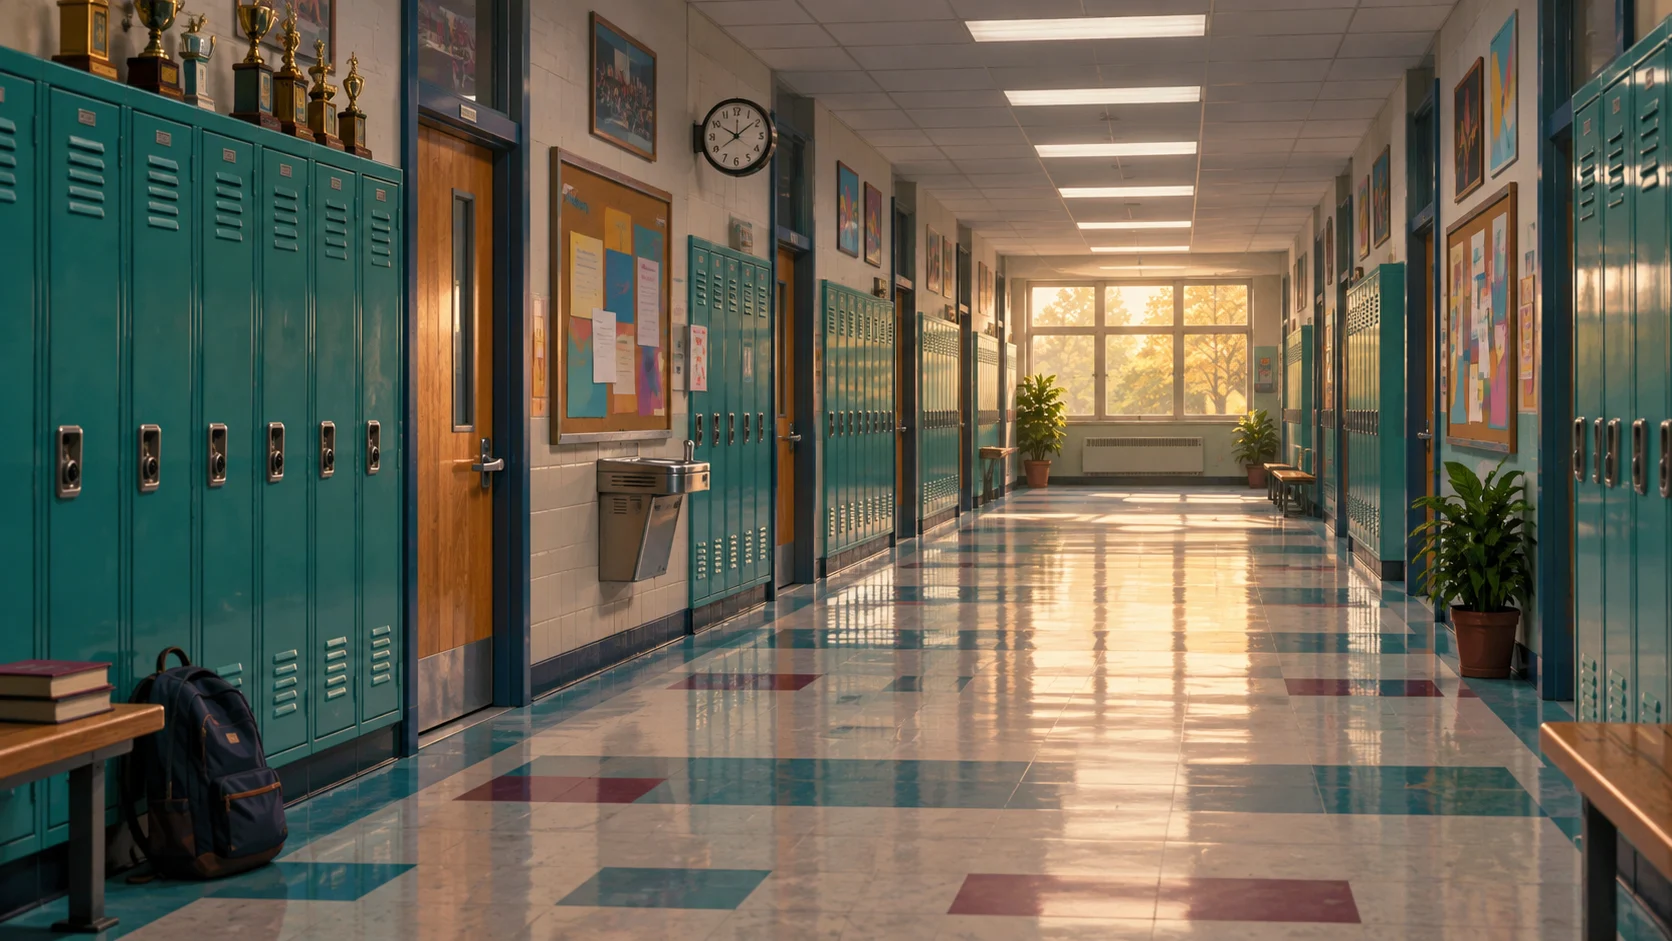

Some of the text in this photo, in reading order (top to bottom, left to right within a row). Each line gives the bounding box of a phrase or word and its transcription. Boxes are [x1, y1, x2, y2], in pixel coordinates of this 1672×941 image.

[722, 111, 728, 119] 11
[712, 120, 721, 128] 10
[755, 119, 760, 127] 2
[723, 154, 728, 162] 7
[734, 157, 739, 166] 6
[746, 153, 751, 162] 5
